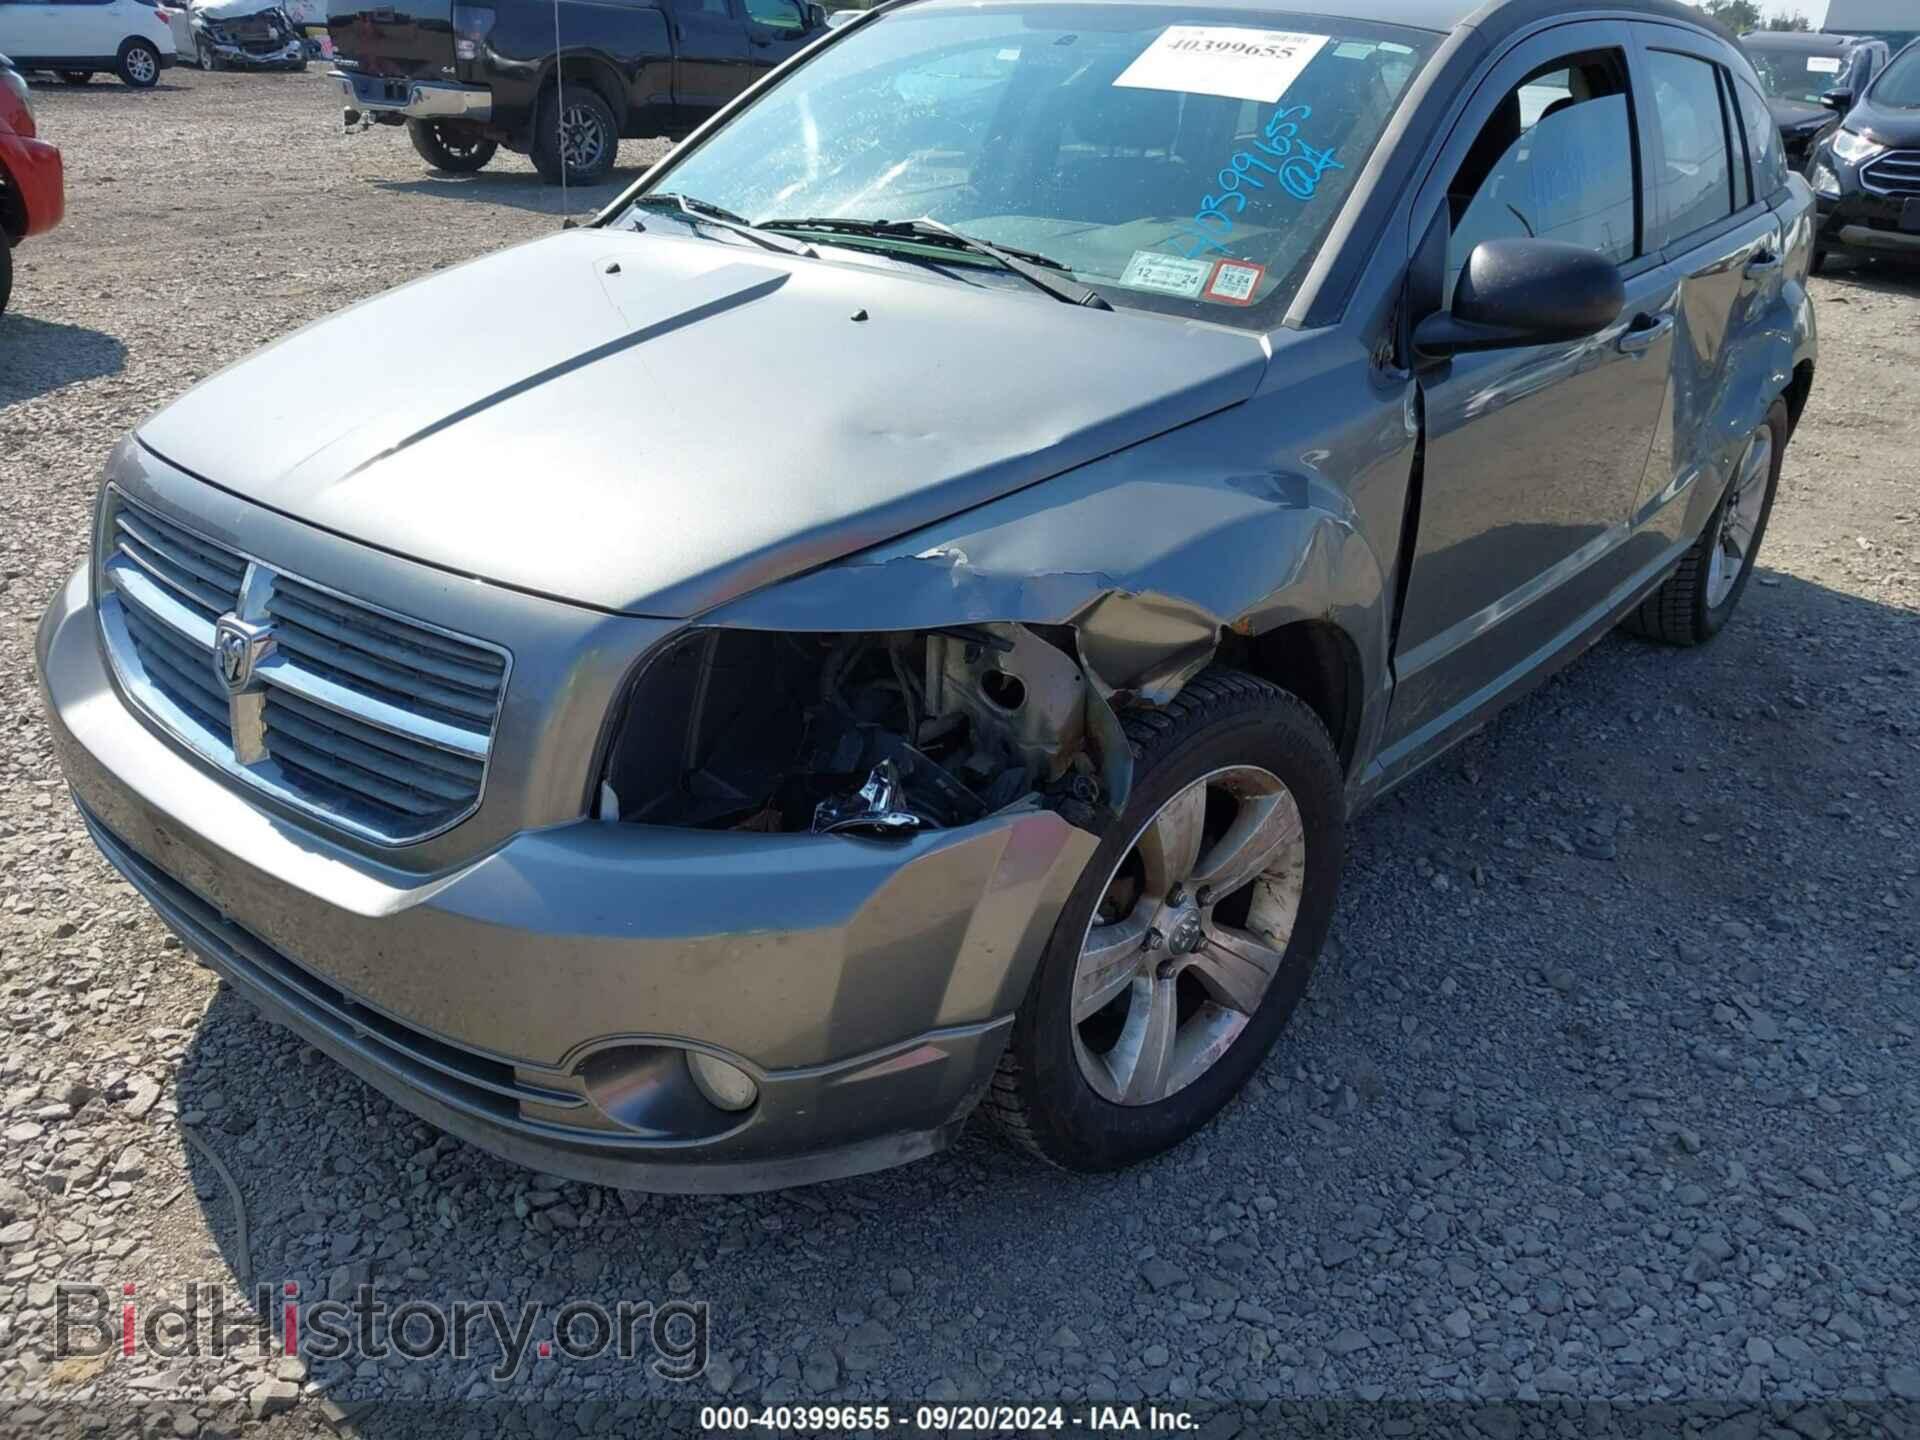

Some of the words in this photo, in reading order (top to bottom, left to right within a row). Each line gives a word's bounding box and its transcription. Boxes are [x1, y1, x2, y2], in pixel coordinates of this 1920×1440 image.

[1167, 38, 1297, 60] 40399655
[1136, 267, 1152, 279] 12
[1181, 273, 1198, 286] 24
